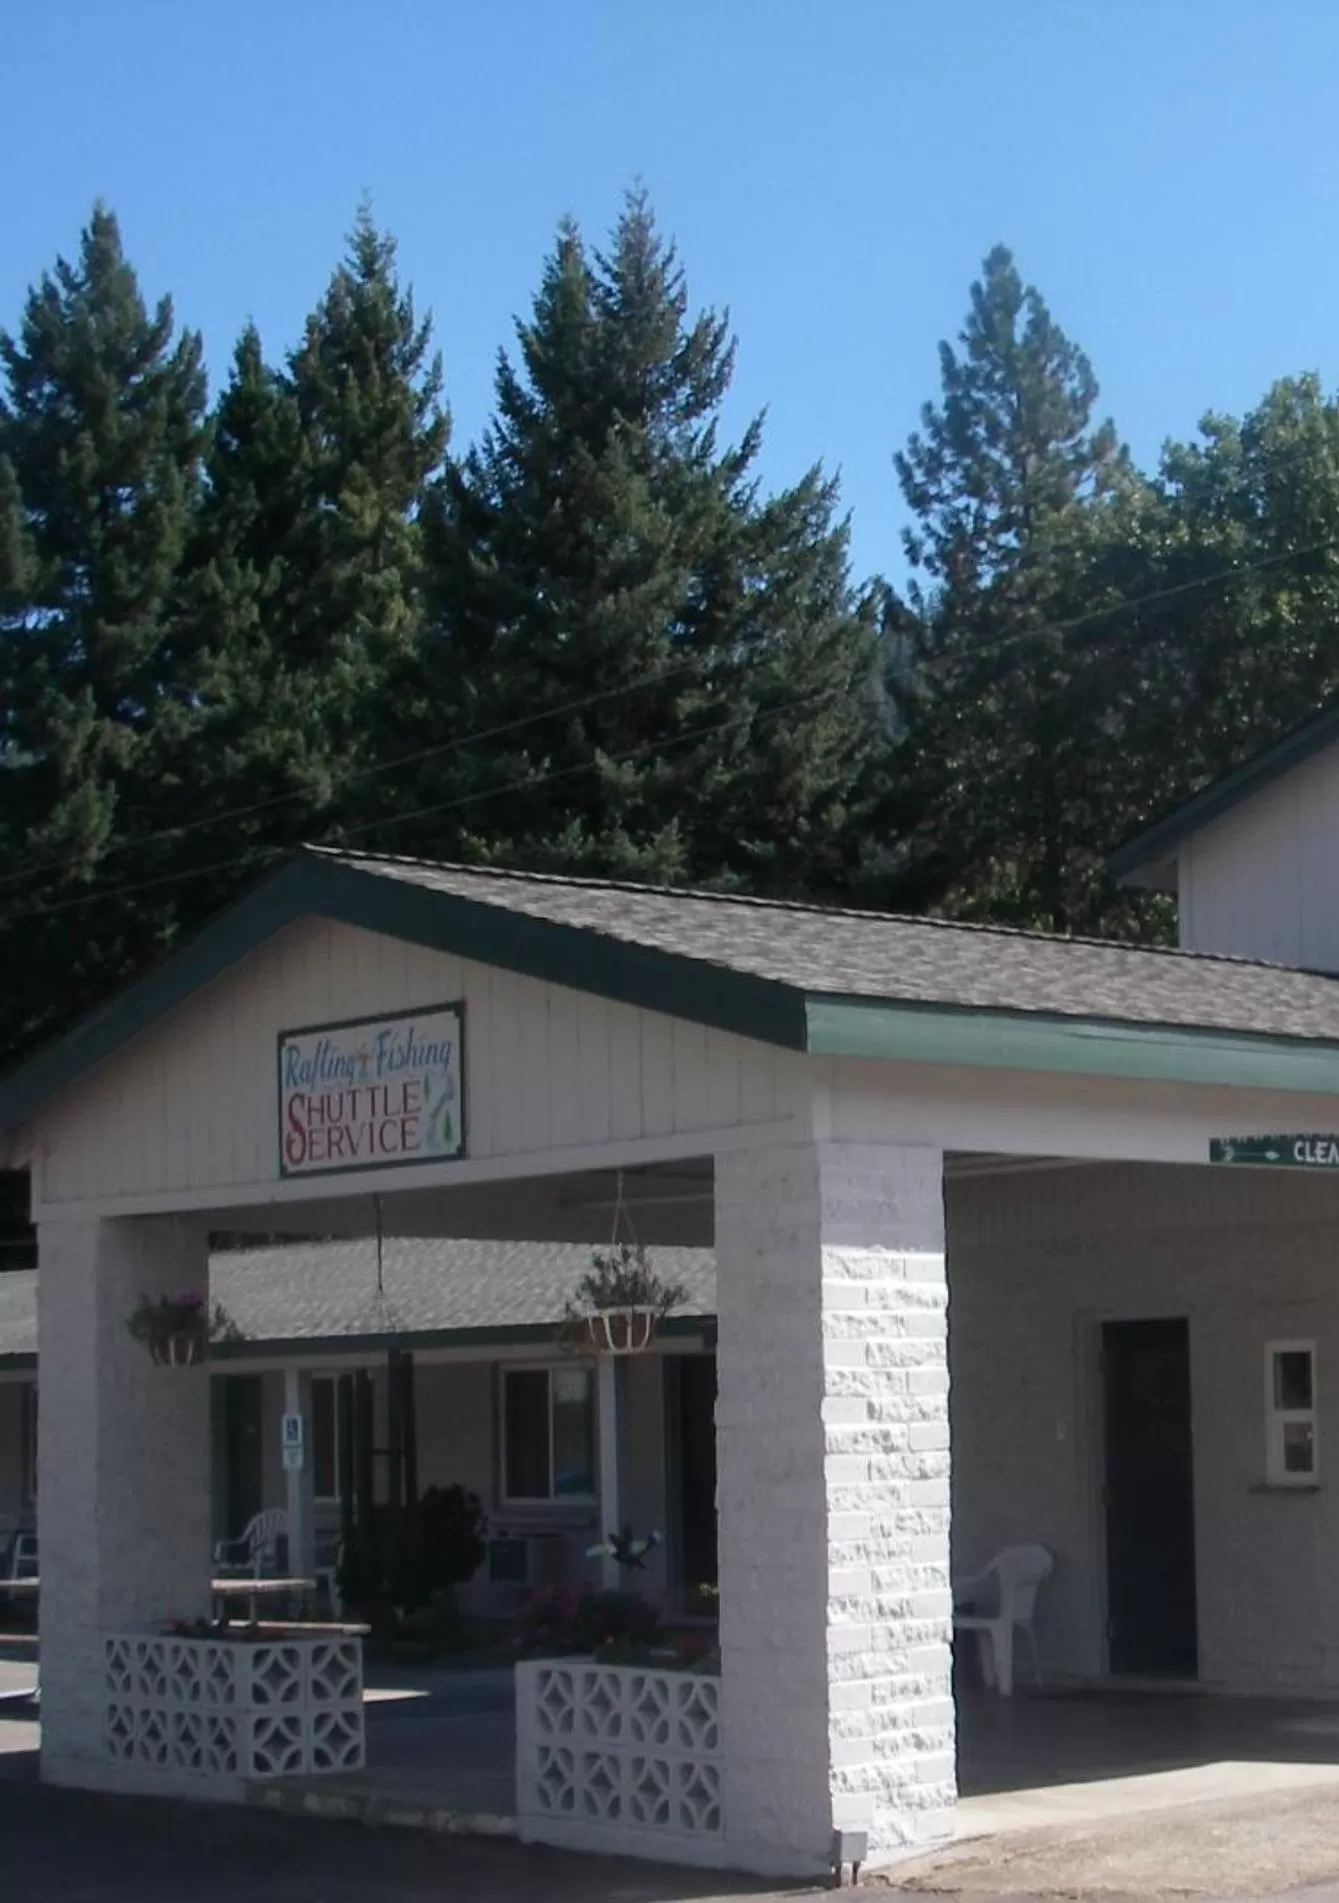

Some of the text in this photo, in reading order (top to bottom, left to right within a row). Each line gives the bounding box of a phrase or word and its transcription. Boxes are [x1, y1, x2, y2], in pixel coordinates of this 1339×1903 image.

[376, 1026, 452, 1077] Fishing
[288, 1079, 422, 1129] SHUTTLE
[286, 1115, 421, 1165] SERVICE
